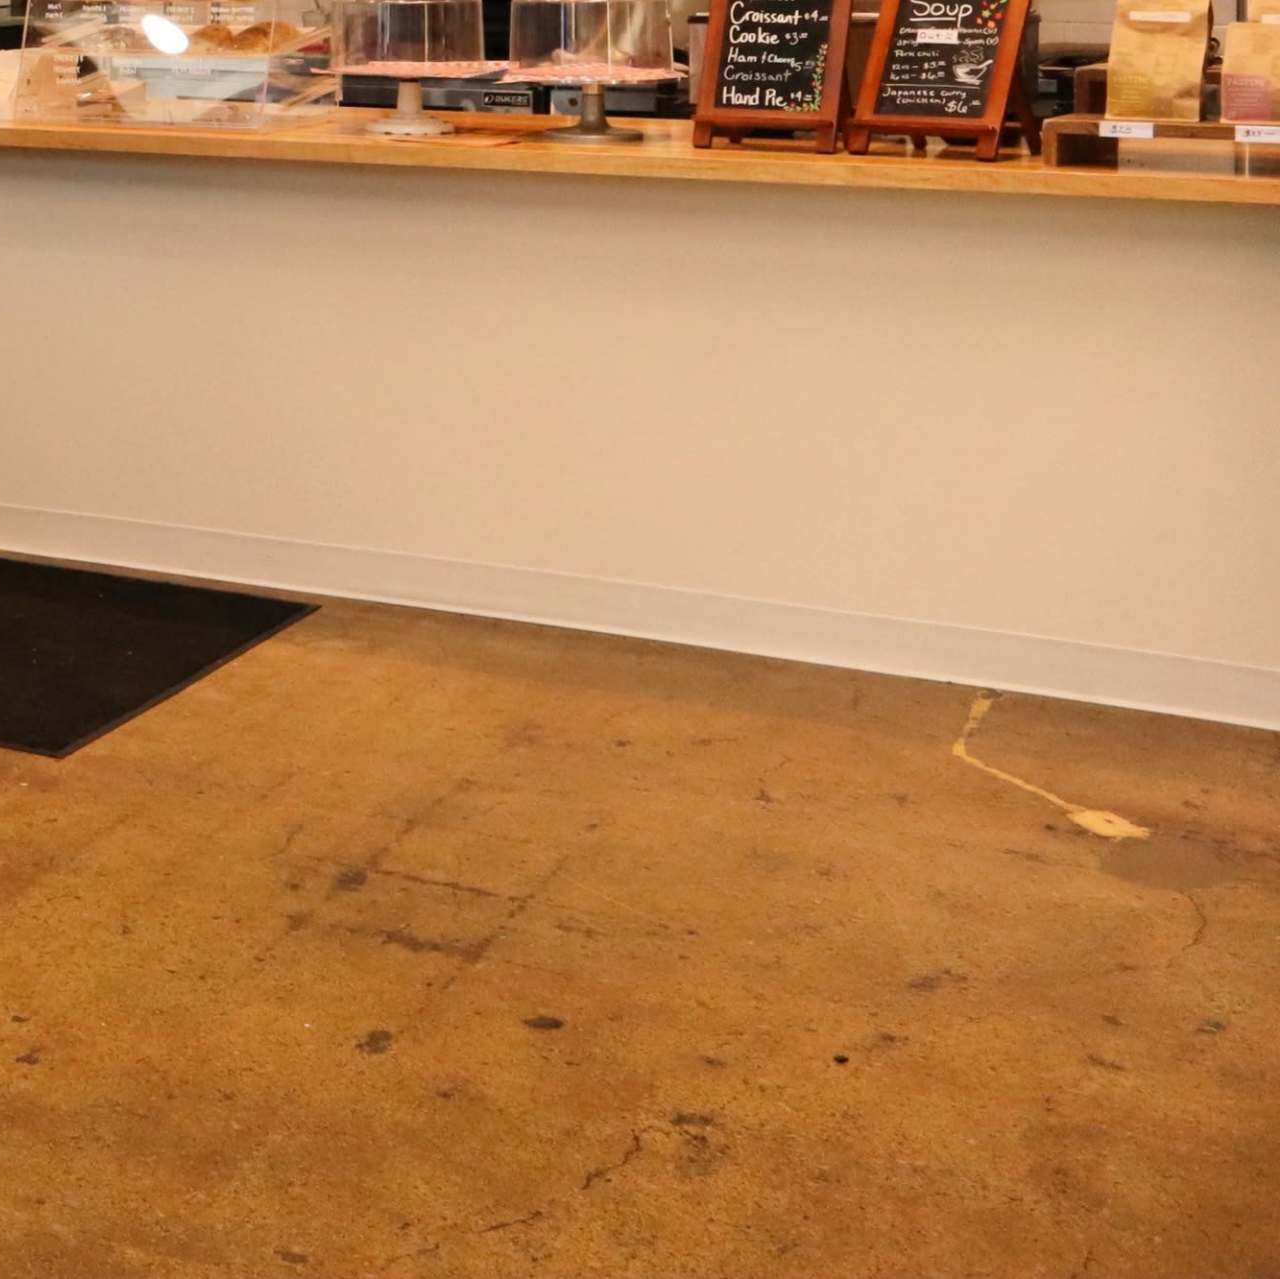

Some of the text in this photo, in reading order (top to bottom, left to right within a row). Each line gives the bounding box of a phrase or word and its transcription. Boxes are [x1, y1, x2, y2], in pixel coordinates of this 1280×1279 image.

[730, 1, 802, 26] Croissant
[729, 25, 780, 44] Cookie
[727, 46, 757, 63] Ham
[723, 65, 792, 82] Croissant
[722, 85, 760, 106] Hand
[765, 88, 787, 107] Pie
